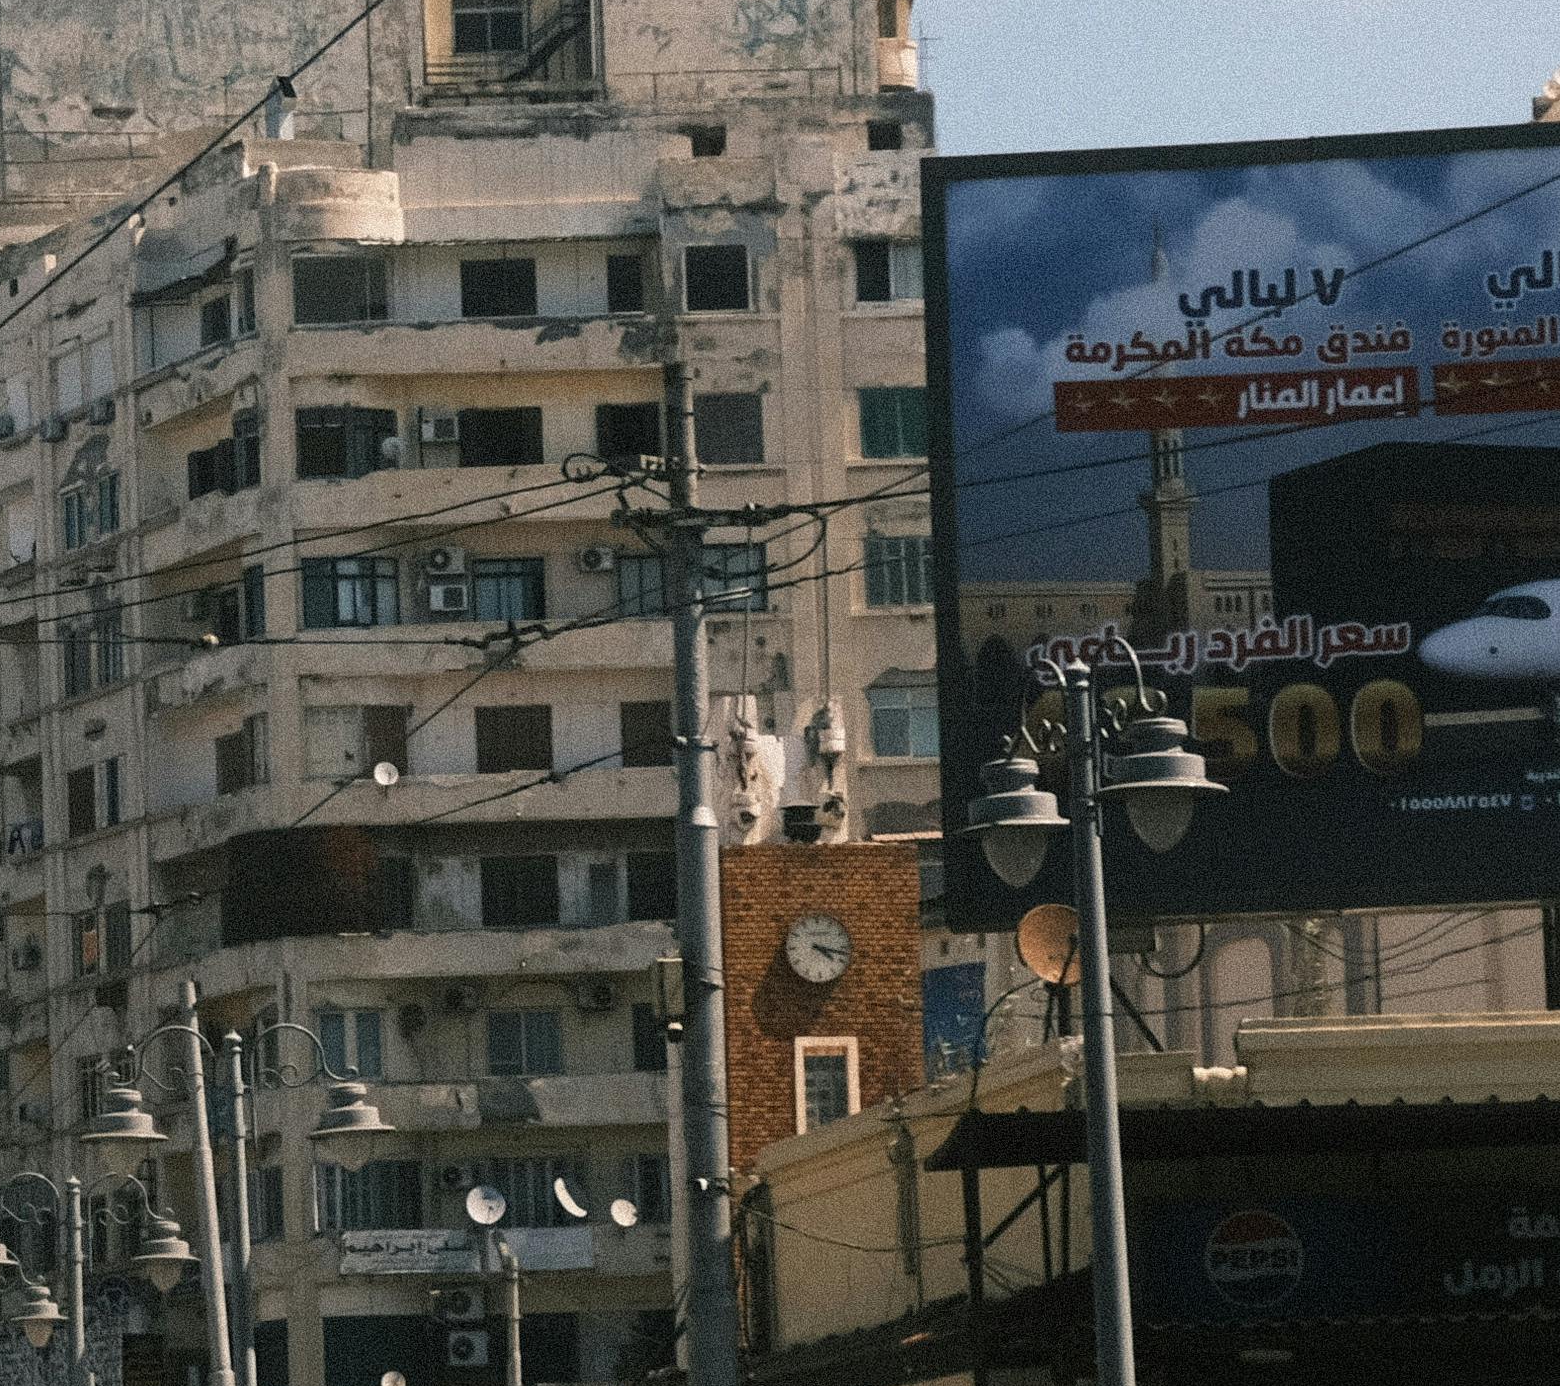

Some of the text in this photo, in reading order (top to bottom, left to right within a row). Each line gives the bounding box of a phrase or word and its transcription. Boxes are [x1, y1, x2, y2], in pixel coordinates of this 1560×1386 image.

[1178, 267, 1298, 317] ليالي
[1064, 323, 1412, 369] فندق مكة المكرمة
[1440, 315, 1558, 357] المنورة
[1236, 381, 1320, 419] المنار
[1204, 613, 1314, 673] الفرد
[1316, 621, 1412, 669] سعر
[1446, 1257, 1550, 1299] الرمل
